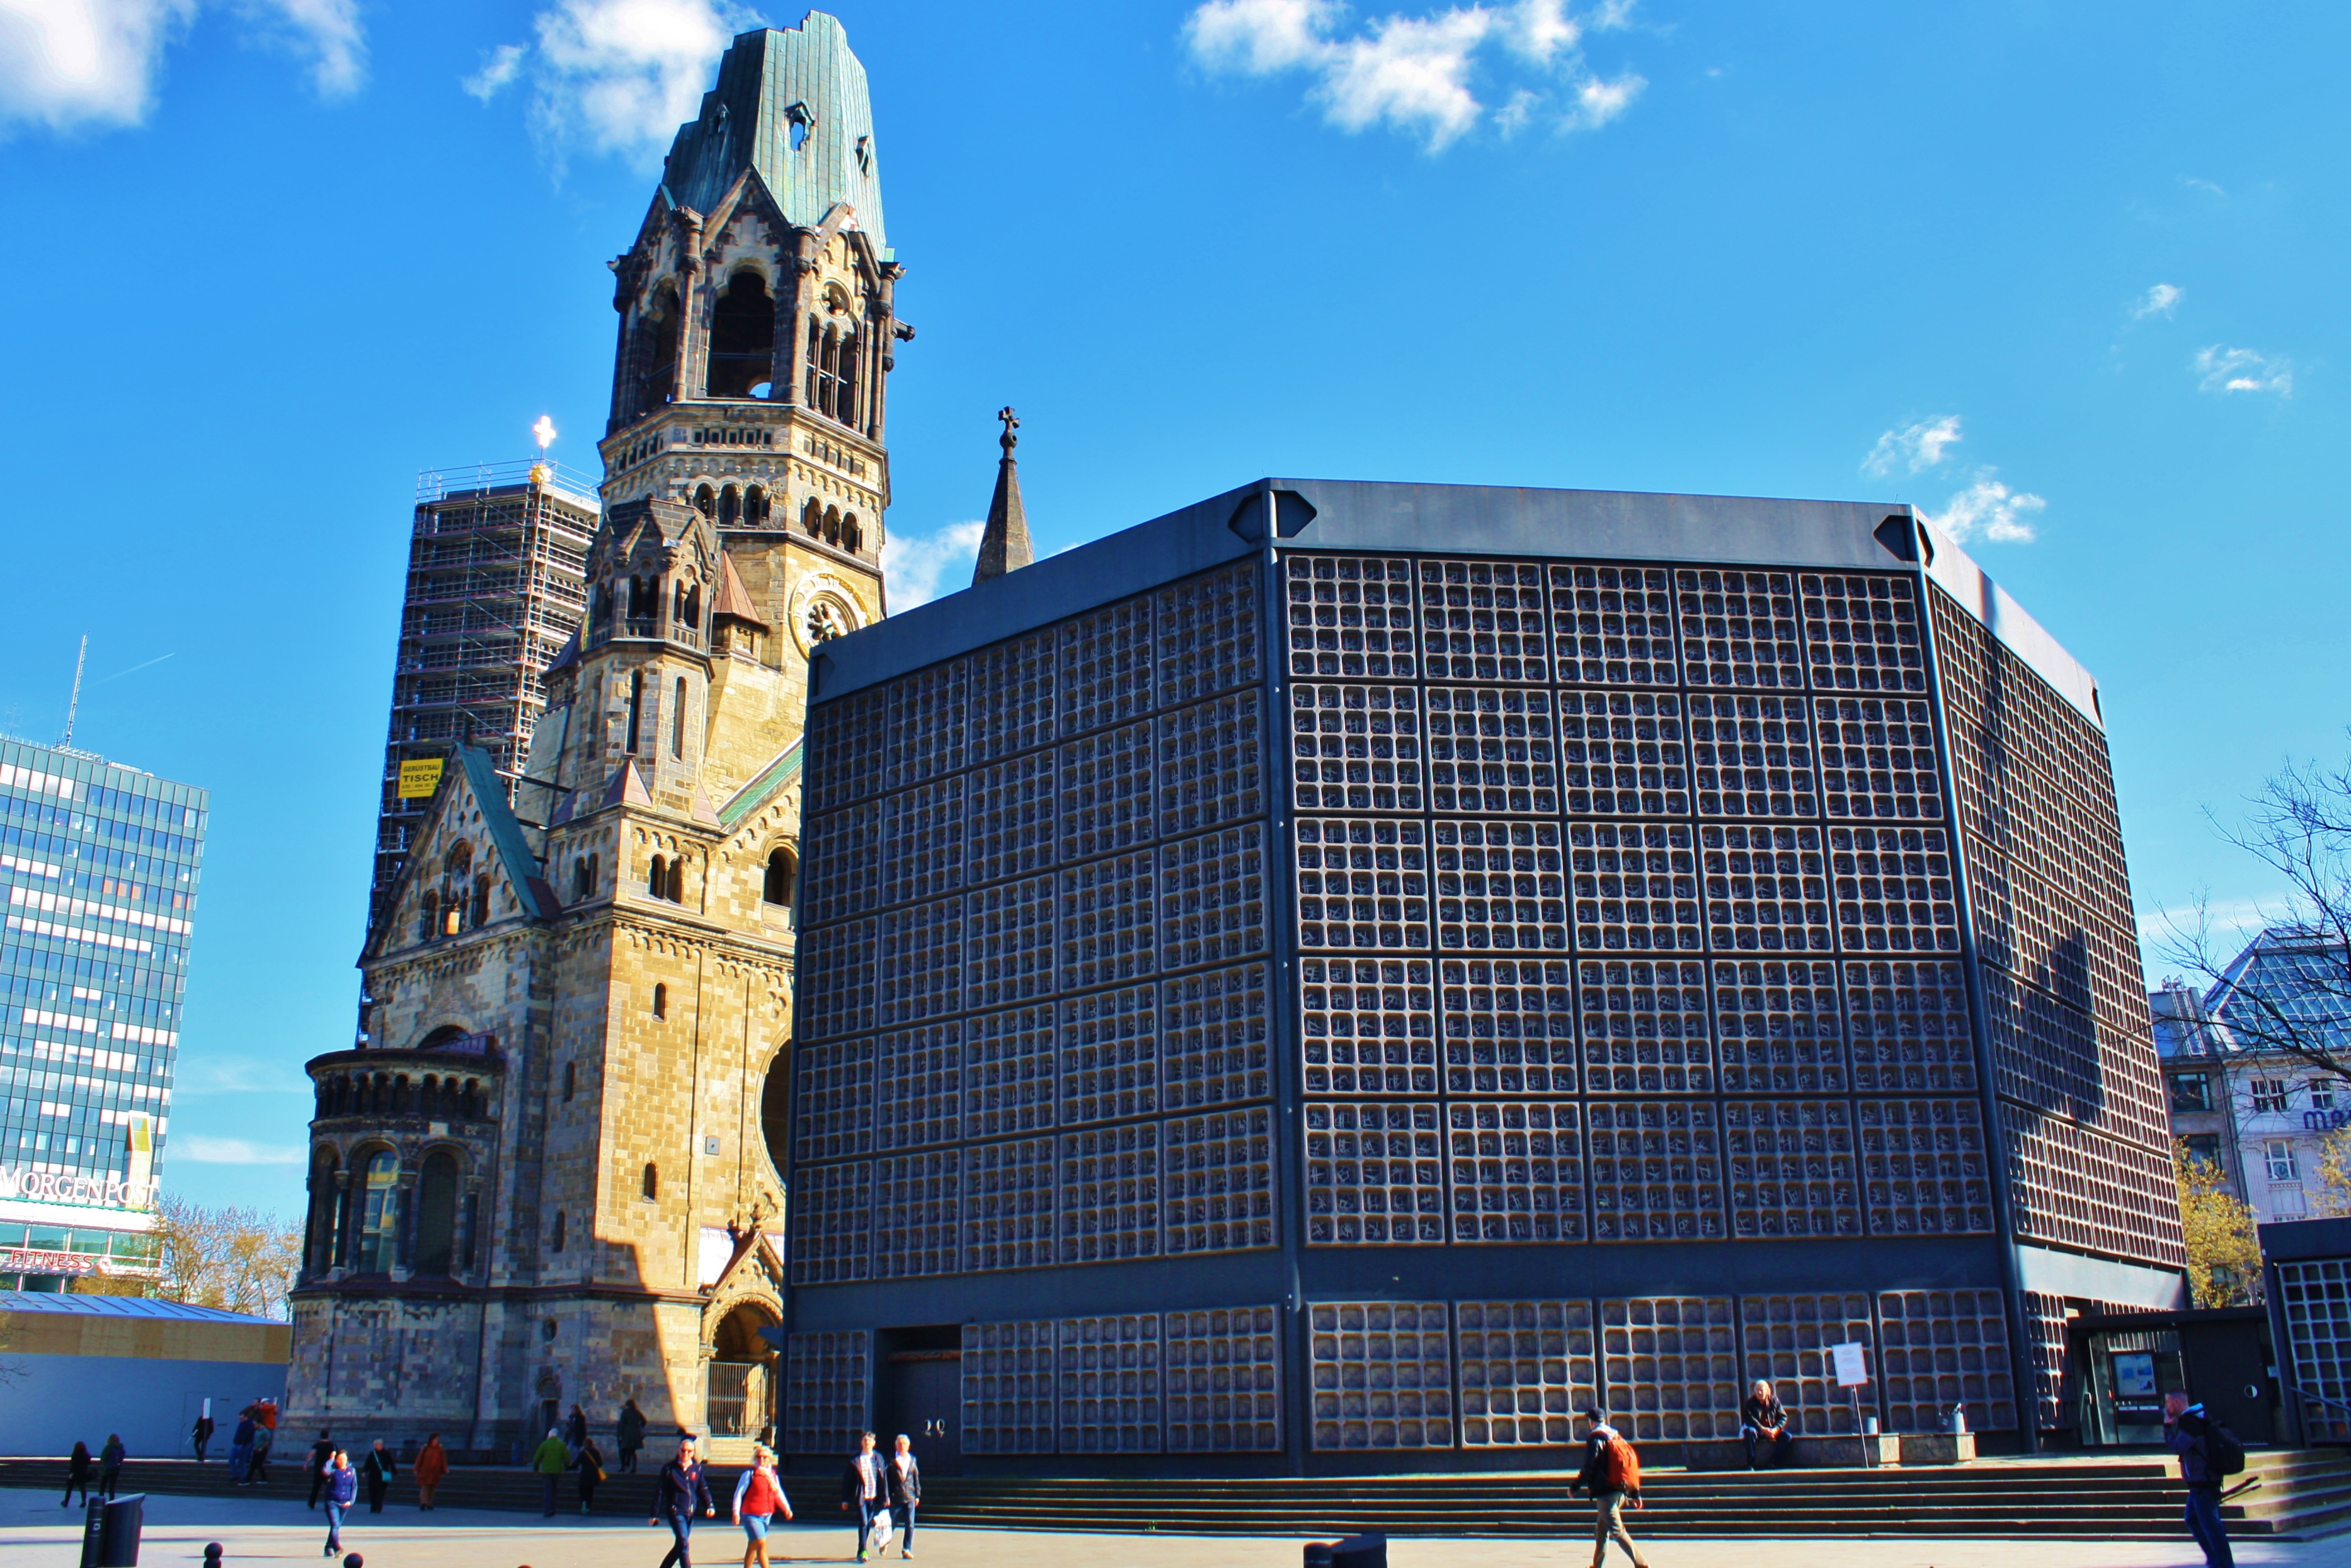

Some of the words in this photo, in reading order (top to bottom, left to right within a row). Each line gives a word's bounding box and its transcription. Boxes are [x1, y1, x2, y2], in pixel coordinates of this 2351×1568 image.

[403, 764, 440, 772] GERÜSTBAU
[403, 774, 438, 782] TISCH
[0, 1166, 159, 1206] MORGENPOST
[12, 1250, 93, 1269] FITNESS
